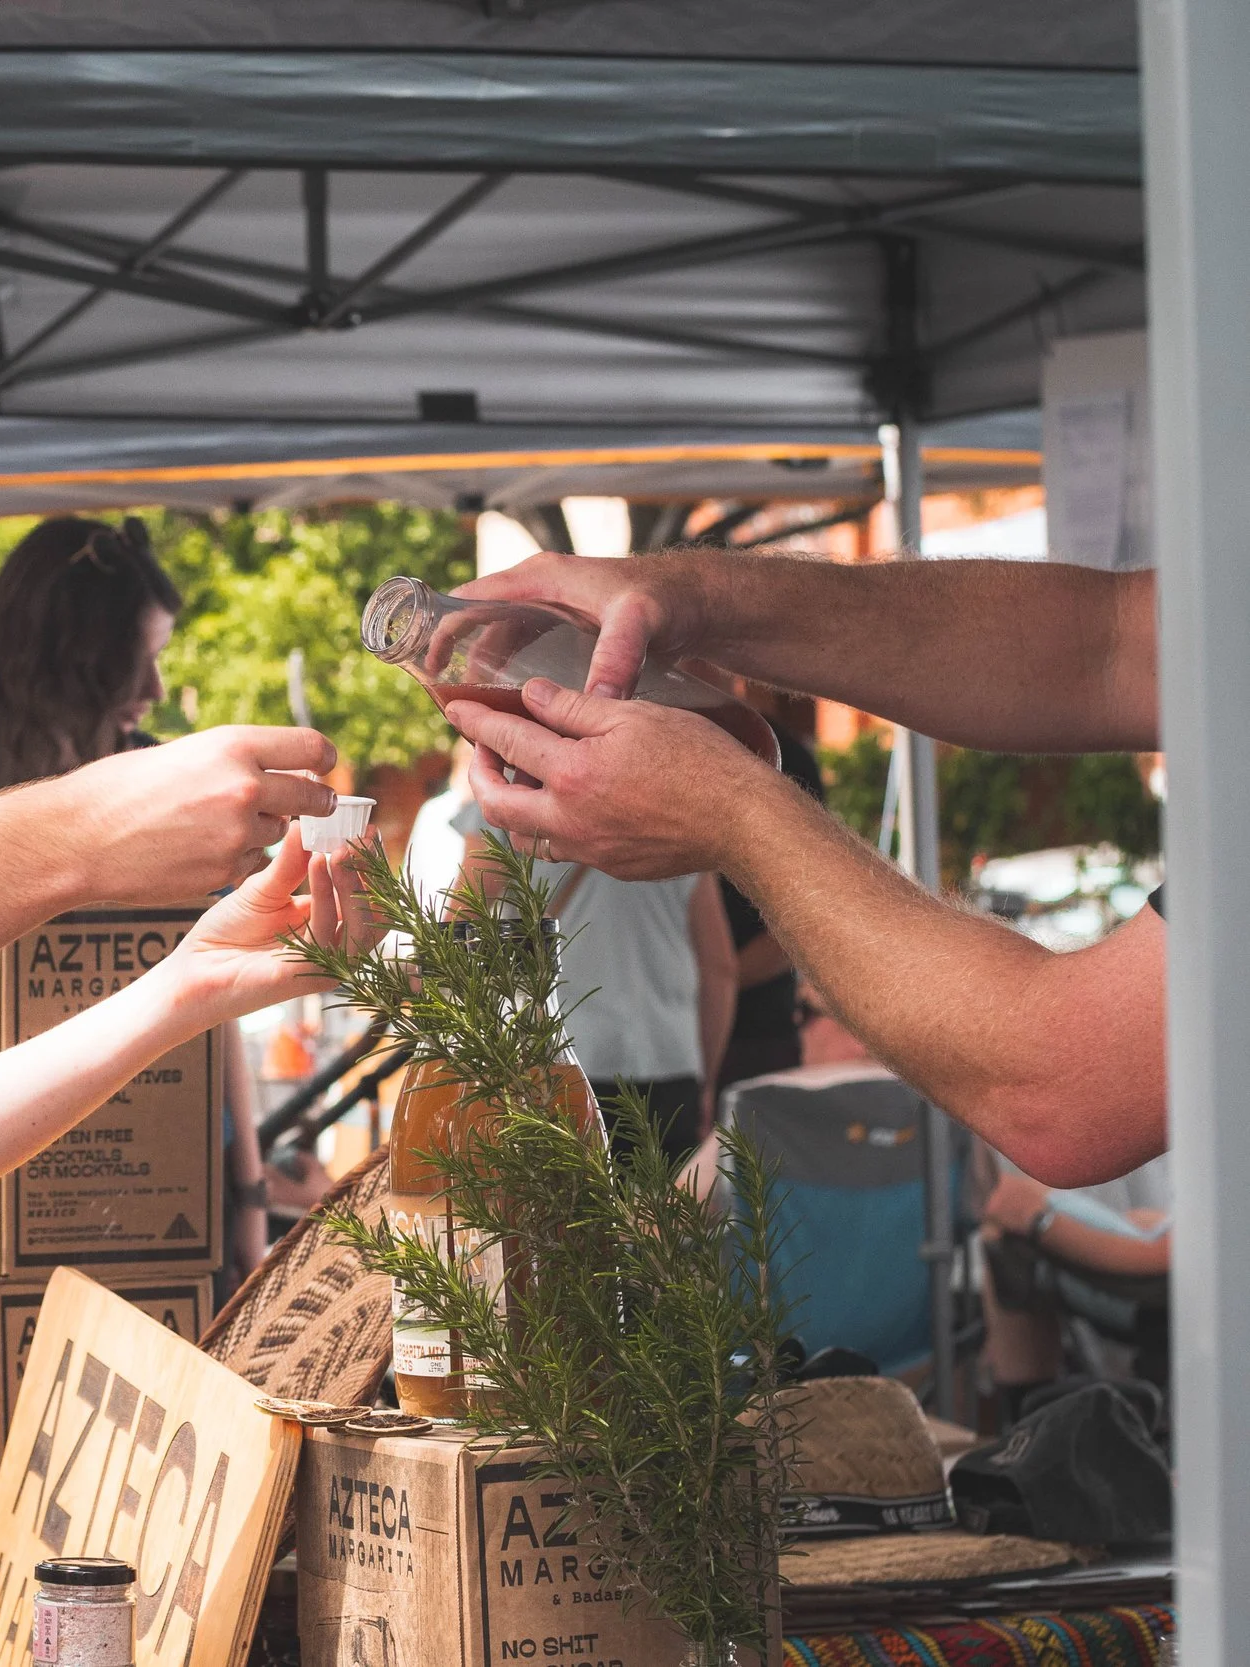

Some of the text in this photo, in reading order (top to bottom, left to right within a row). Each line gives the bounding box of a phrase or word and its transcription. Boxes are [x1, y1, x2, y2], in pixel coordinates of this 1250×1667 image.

[30, 931, 187, 973] AZTEC
[28, 977, 139, 998] MARGA
[94, 1128, 134, 1143] FREE
[27, 1162, 151, 1180] OR MOCKTAILS
[12, 1338, 231, 1667] AZTECA
[329, 1473, 412, 1544] AZTECA
[328, 1533, 414, 1579] MARGARITA
[501, 1633, 599, 1660] NO SHIT
